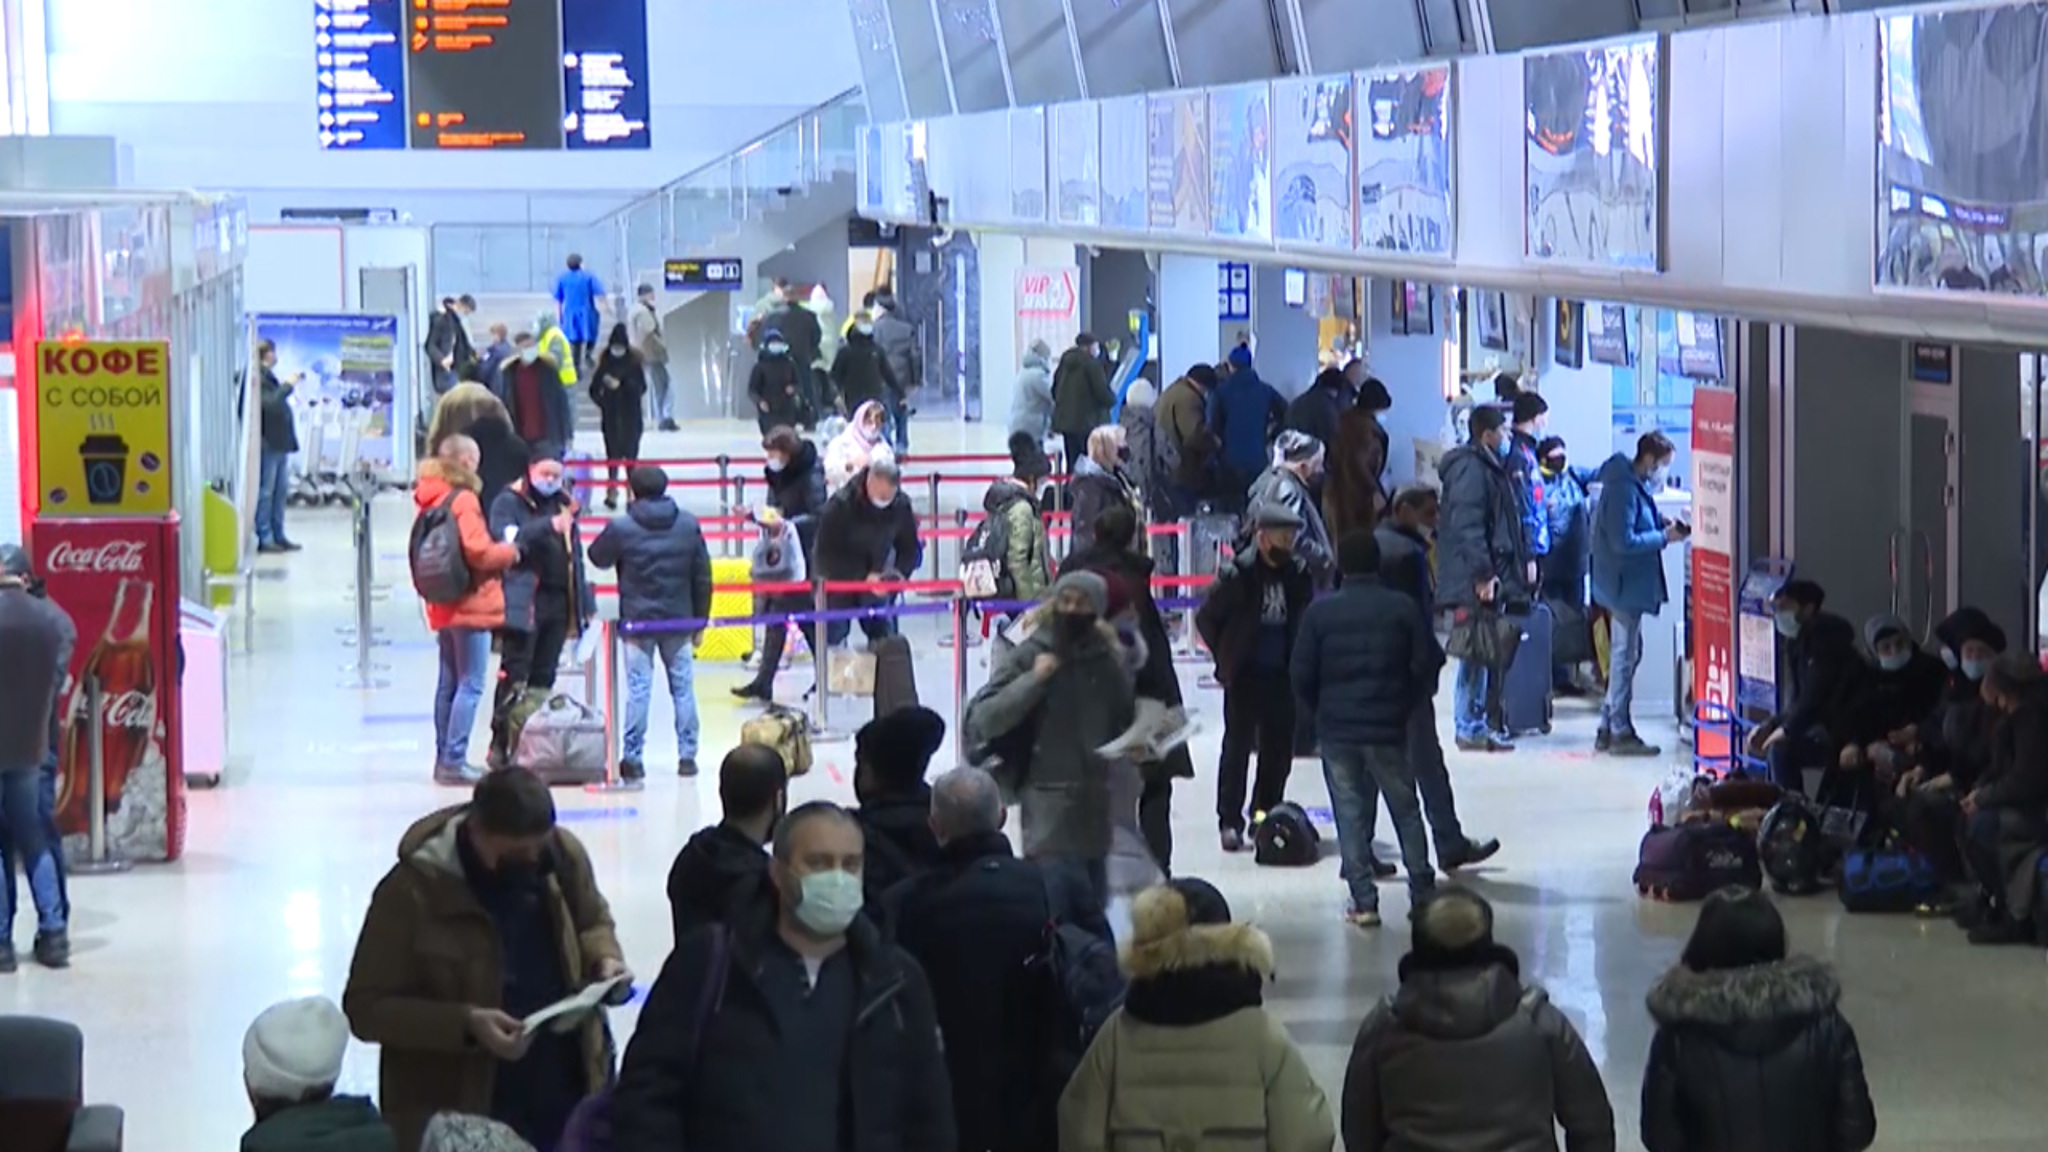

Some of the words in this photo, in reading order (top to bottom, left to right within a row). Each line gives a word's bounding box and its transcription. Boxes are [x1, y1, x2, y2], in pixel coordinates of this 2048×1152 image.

[1024, 275, 1050, 294] VIP
[43, 348, 160, 376] КОФЕ
[46, 387, 63, 408] С
[71, 384, 161, 408] СОБОЙ
[46, 540, 146, 573] Coca-Cola
